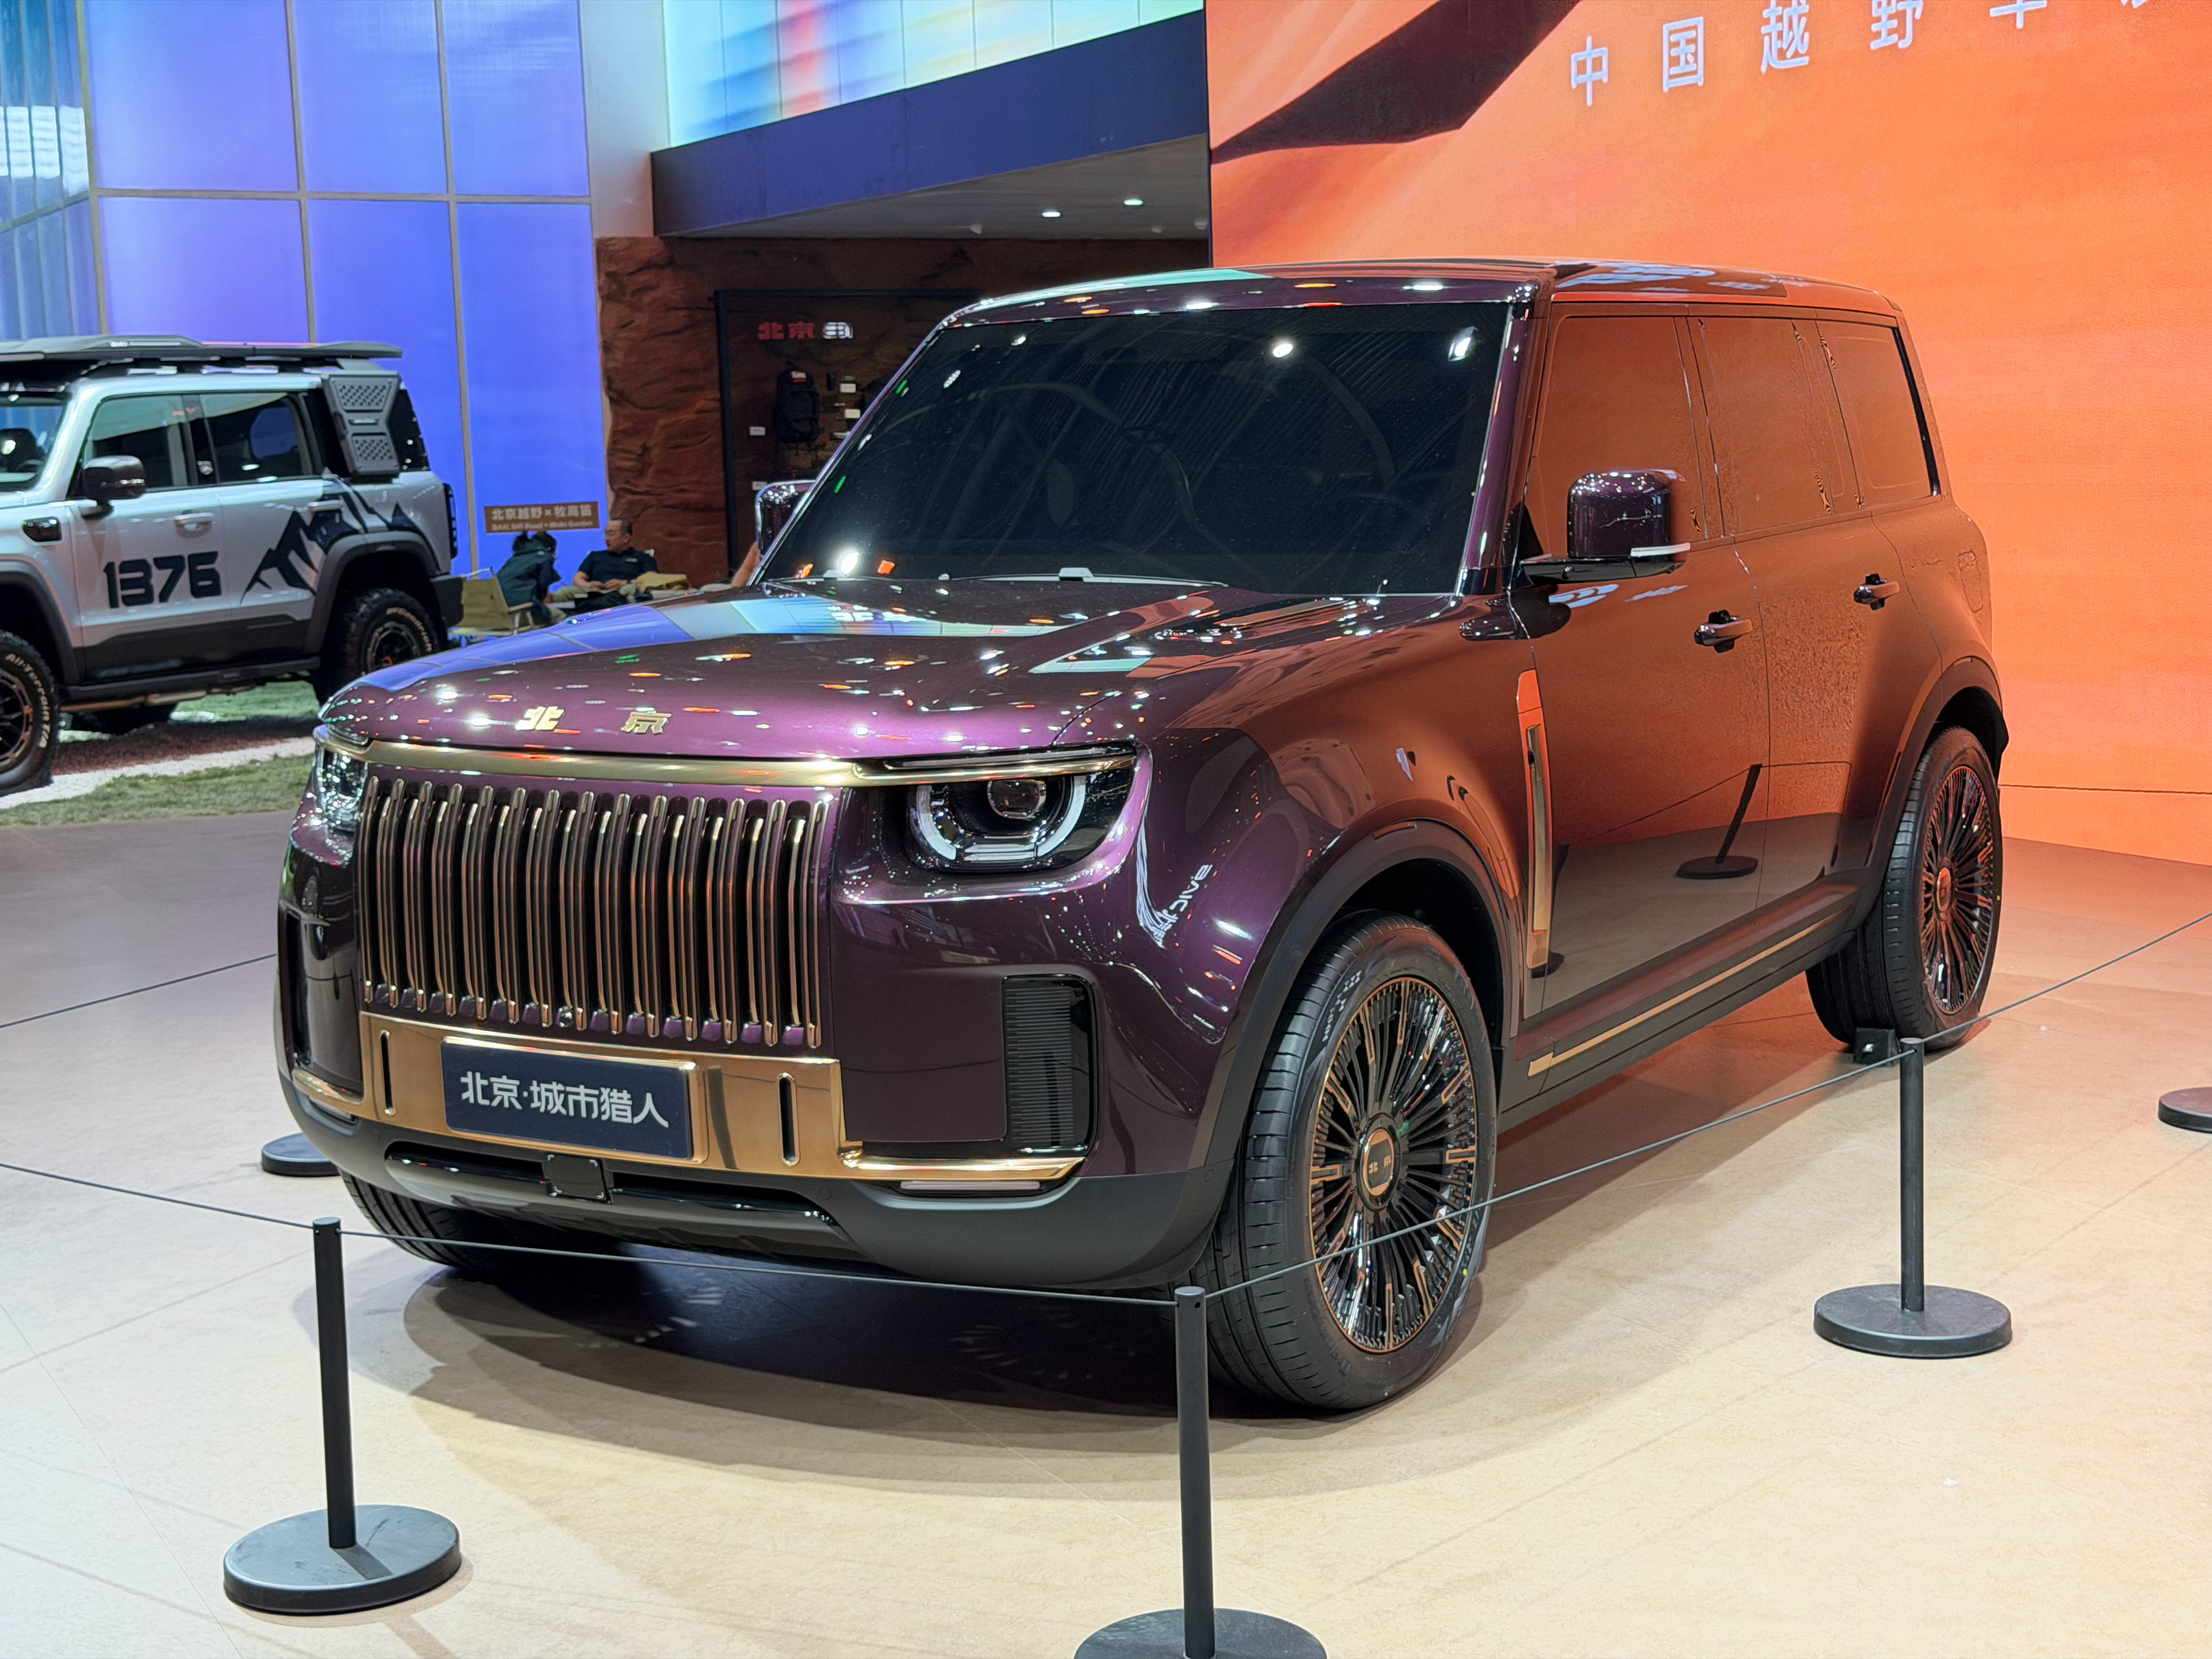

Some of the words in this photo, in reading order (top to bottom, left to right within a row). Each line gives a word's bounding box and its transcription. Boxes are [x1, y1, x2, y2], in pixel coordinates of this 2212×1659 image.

[1570, 0, 2144, 106] 中国越野
[758, 321, 815, 340] 北京
[103, 551, 222, 609] 1376
[515, 706, 672, 735] 北京
